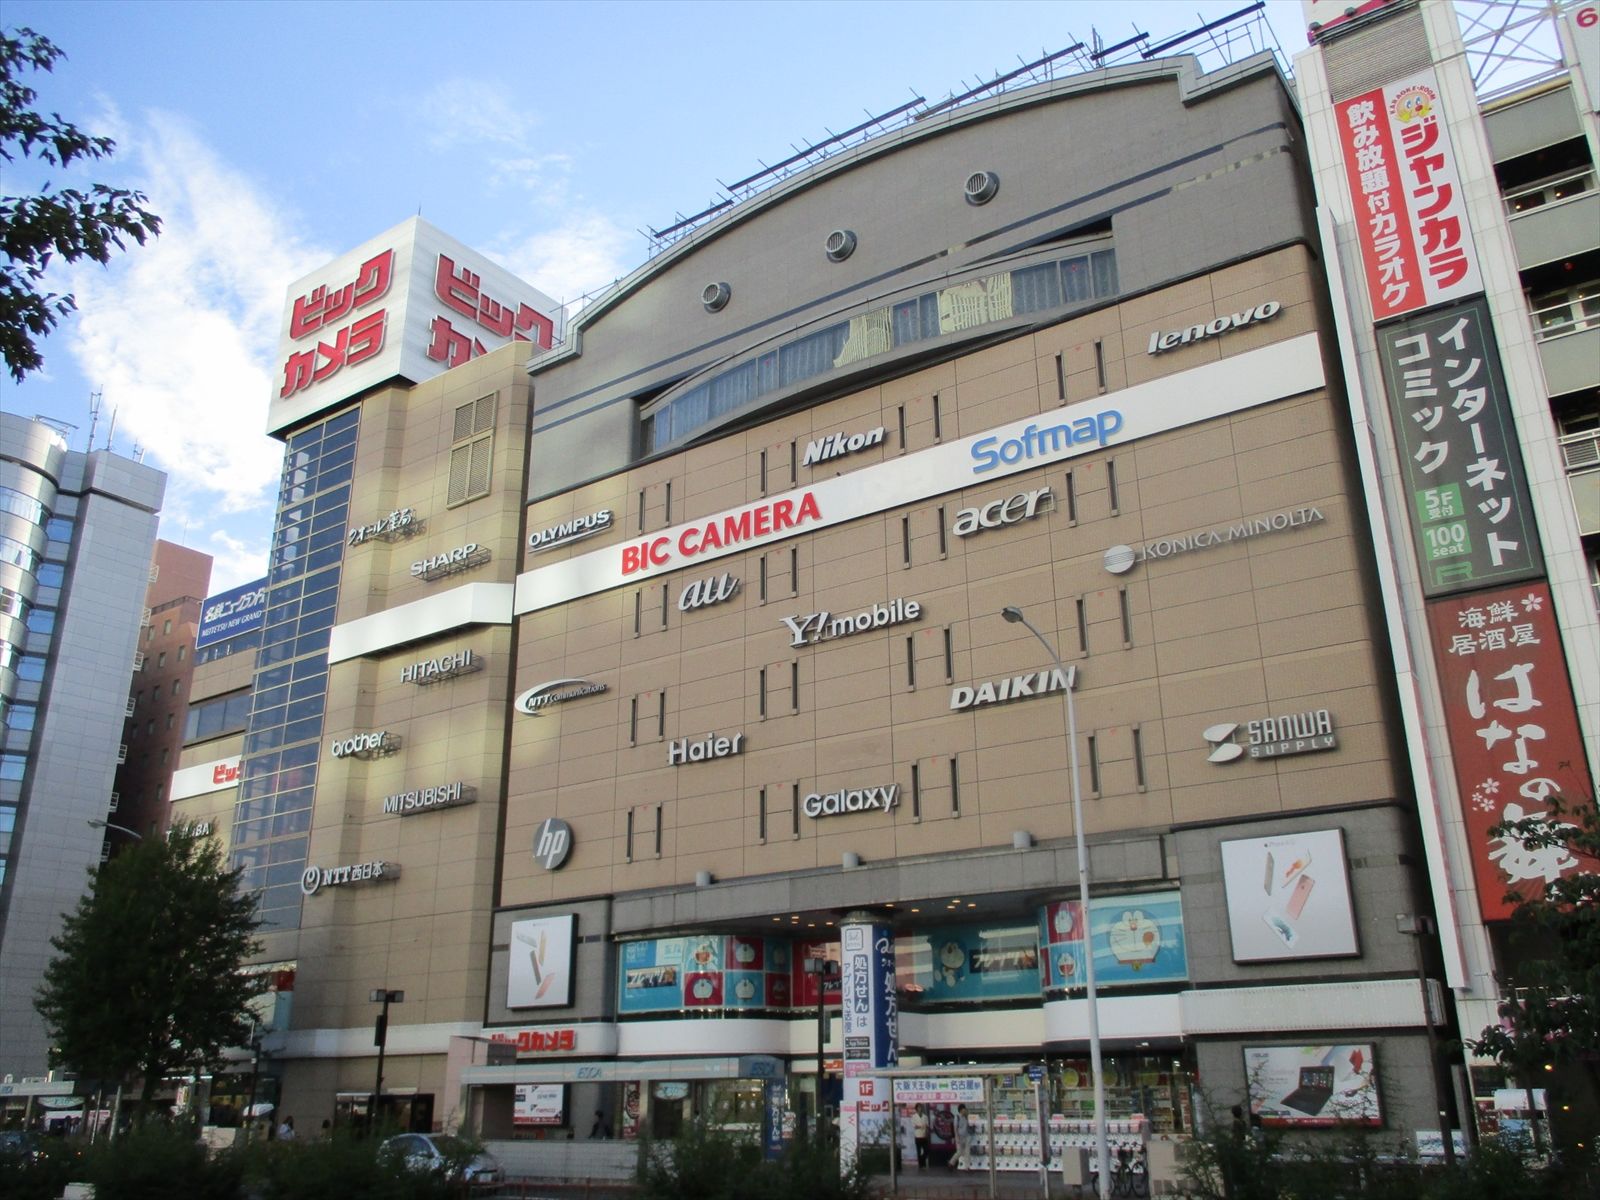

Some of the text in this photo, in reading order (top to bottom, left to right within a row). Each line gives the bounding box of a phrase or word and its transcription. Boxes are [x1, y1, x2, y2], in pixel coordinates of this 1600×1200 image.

[1577, 7, 1599, 28] 6
[1345, 99, 1410, 308] 飲み放題付カラオケ
[1400, 115, 1469, 290] ジャンカラ
[289, 247, 395, 341] ビック
[434, 252, 555, 351] ビック
[1147, 299, 1282, 356] lenovo
[279, 308, 389, 399] カメラ
[1394, 332, 1449, 474] コミック
[802, 426, 885, 468] Nikon
[970, 409, 1124, 474] Sofmap
[1438, 317, 1519, 567] インターネット
[952, 486, 1053, 537] acer
[1424, 489, 1454, 509] 5F
[528, 509, 612, 548] OLYMPUS
[621, 491, 822, 576] BIC CAMERA
[1142, 506, 1325, 561] KONICA MINOLTA
[1425, 523, 1466, 548] 100
[410, 543, 478, 577] SHARP
[1432, 542, 1465, 558] seat
[678, 572, 739, 612] au
[779, 598, 921, 648] Y!mobile
[1458, 600, 1520, 629] 海鮮
[1448, 623, 1541, 656] 居酒屋
[401, 649, 472, 684] HITACHI
[528, 692, 551, 708] NTT
[949, 664, 1078, 711] DAIKIN
[332, 730, 387, 758] brother
[1247, 708, 1333, 745] SANWA
[667, 731, 745, 766] Haier
[1250, 736, 1335, 758] SUPPLY
[384, 782, 463, 814] MITSUBISHI
[803, 783, 897, 819] Galaxy
[536, 818, 567, 870] hp
[860, 1083, 873, 1095] 1F
